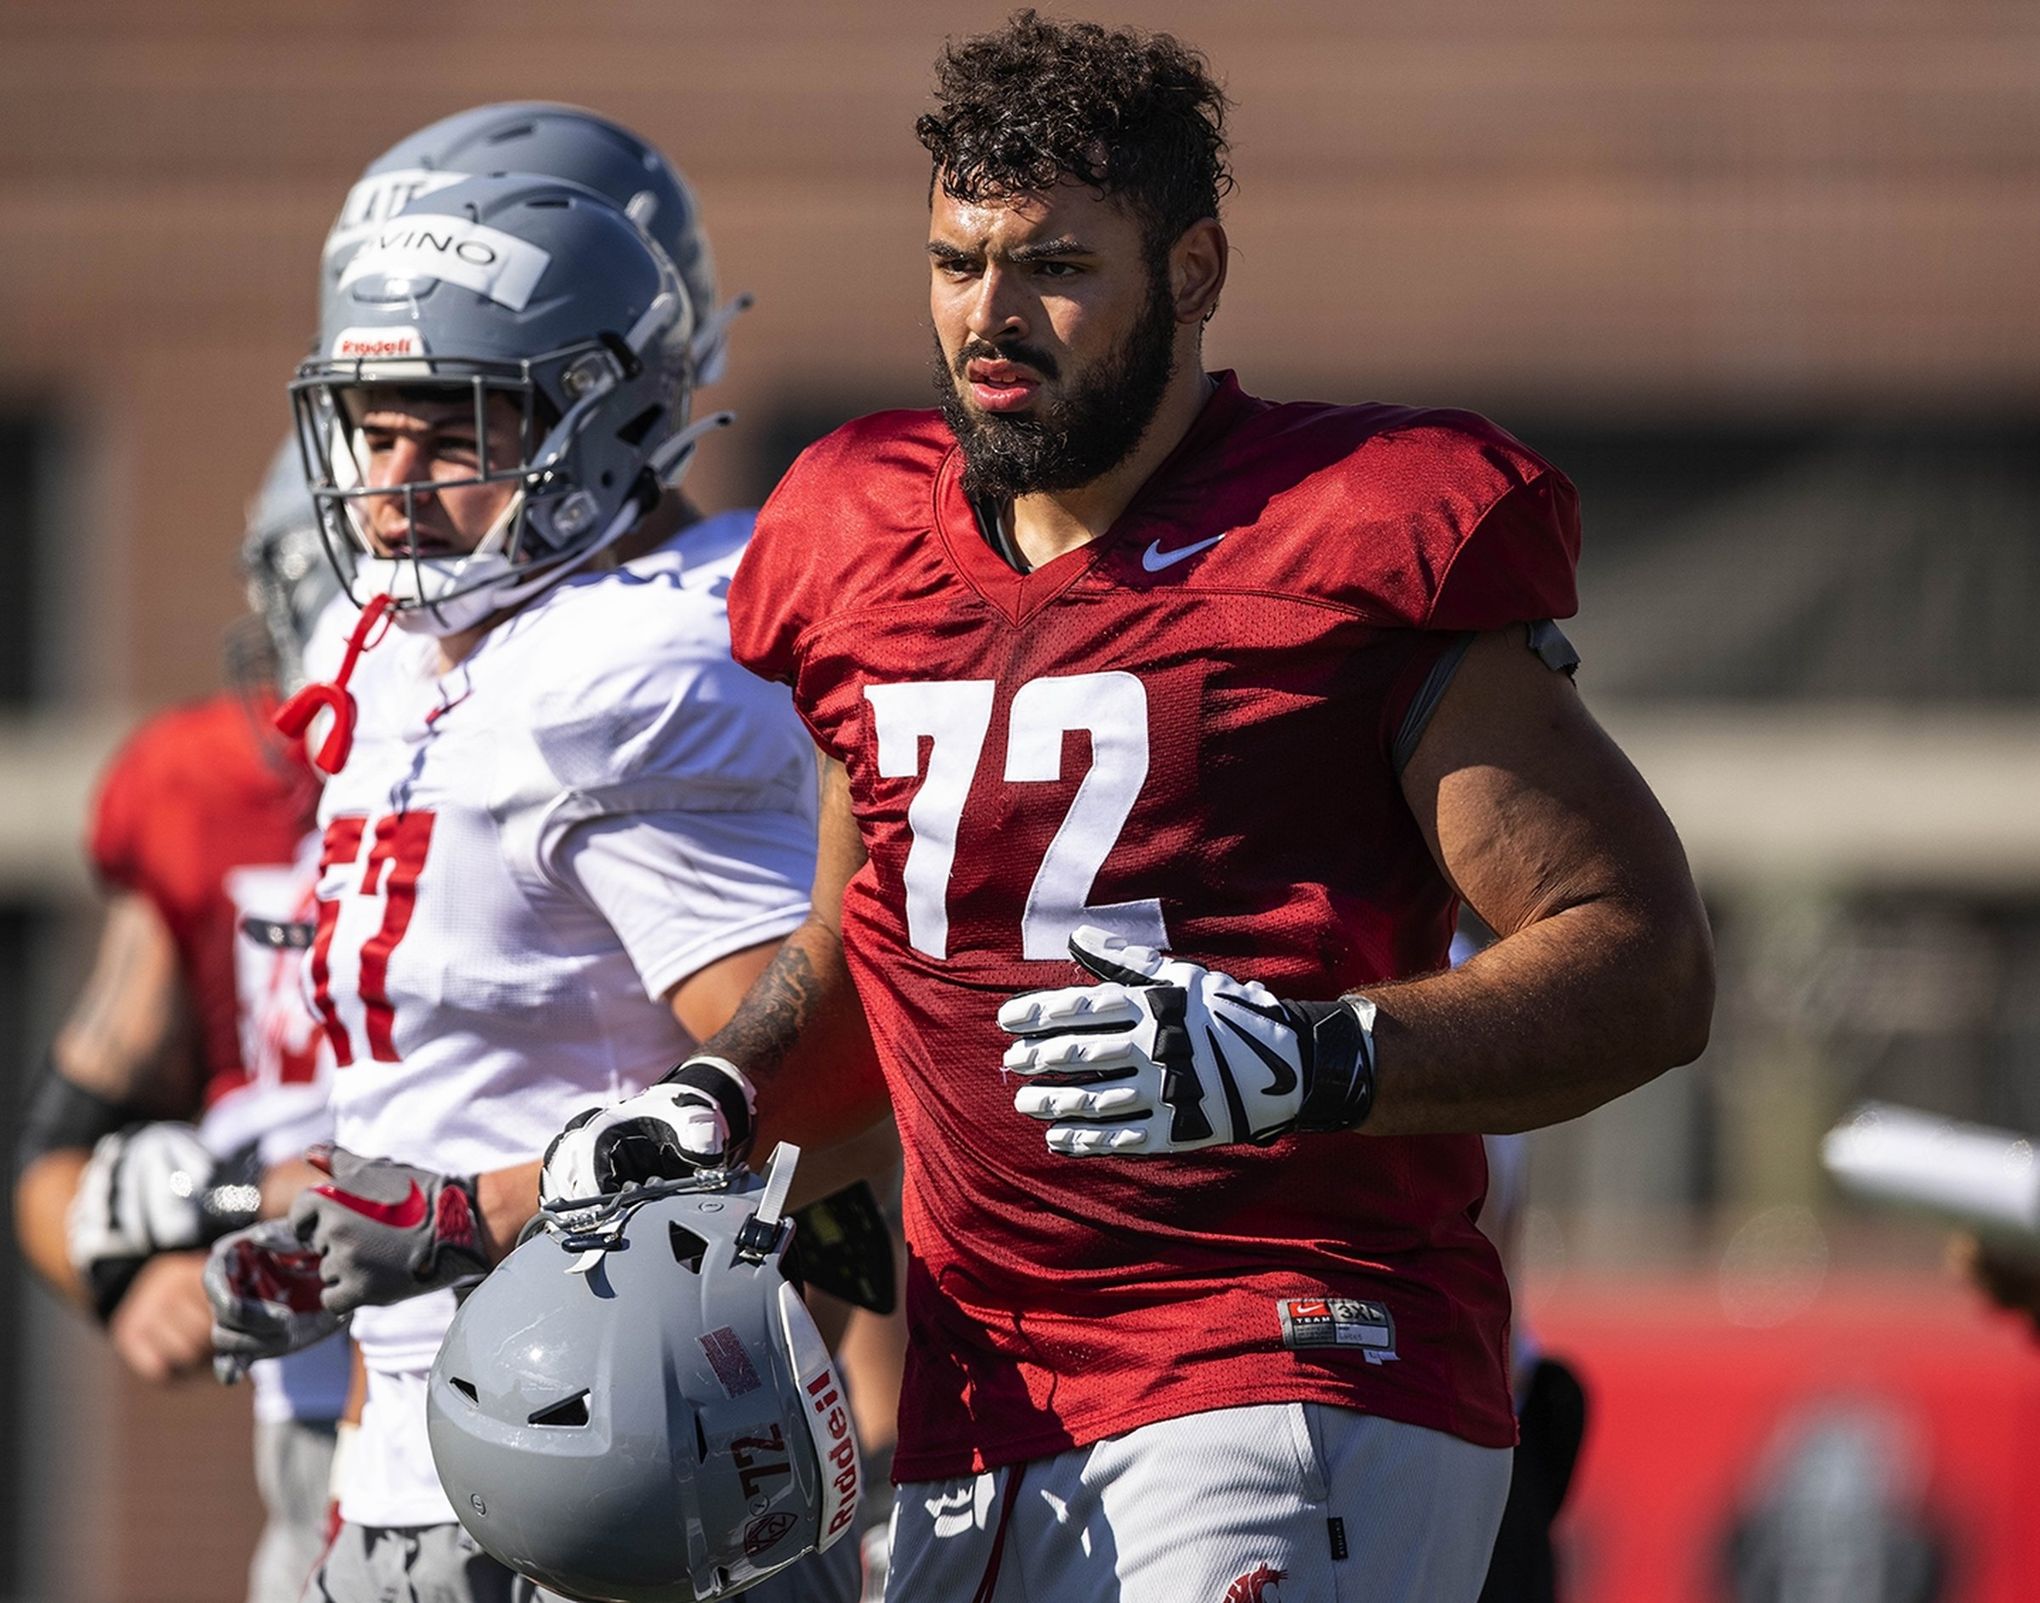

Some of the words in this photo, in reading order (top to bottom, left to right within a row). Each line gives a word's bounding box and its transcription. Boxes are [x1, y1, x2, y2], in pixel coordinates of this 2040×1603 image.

[863, 670, 1171, 961] 72
[1338, 1302, 1381, 1321] 3XL
[730, 1422, 791, 1500] 72
[806, 1368, 858, 1536] Riddell
